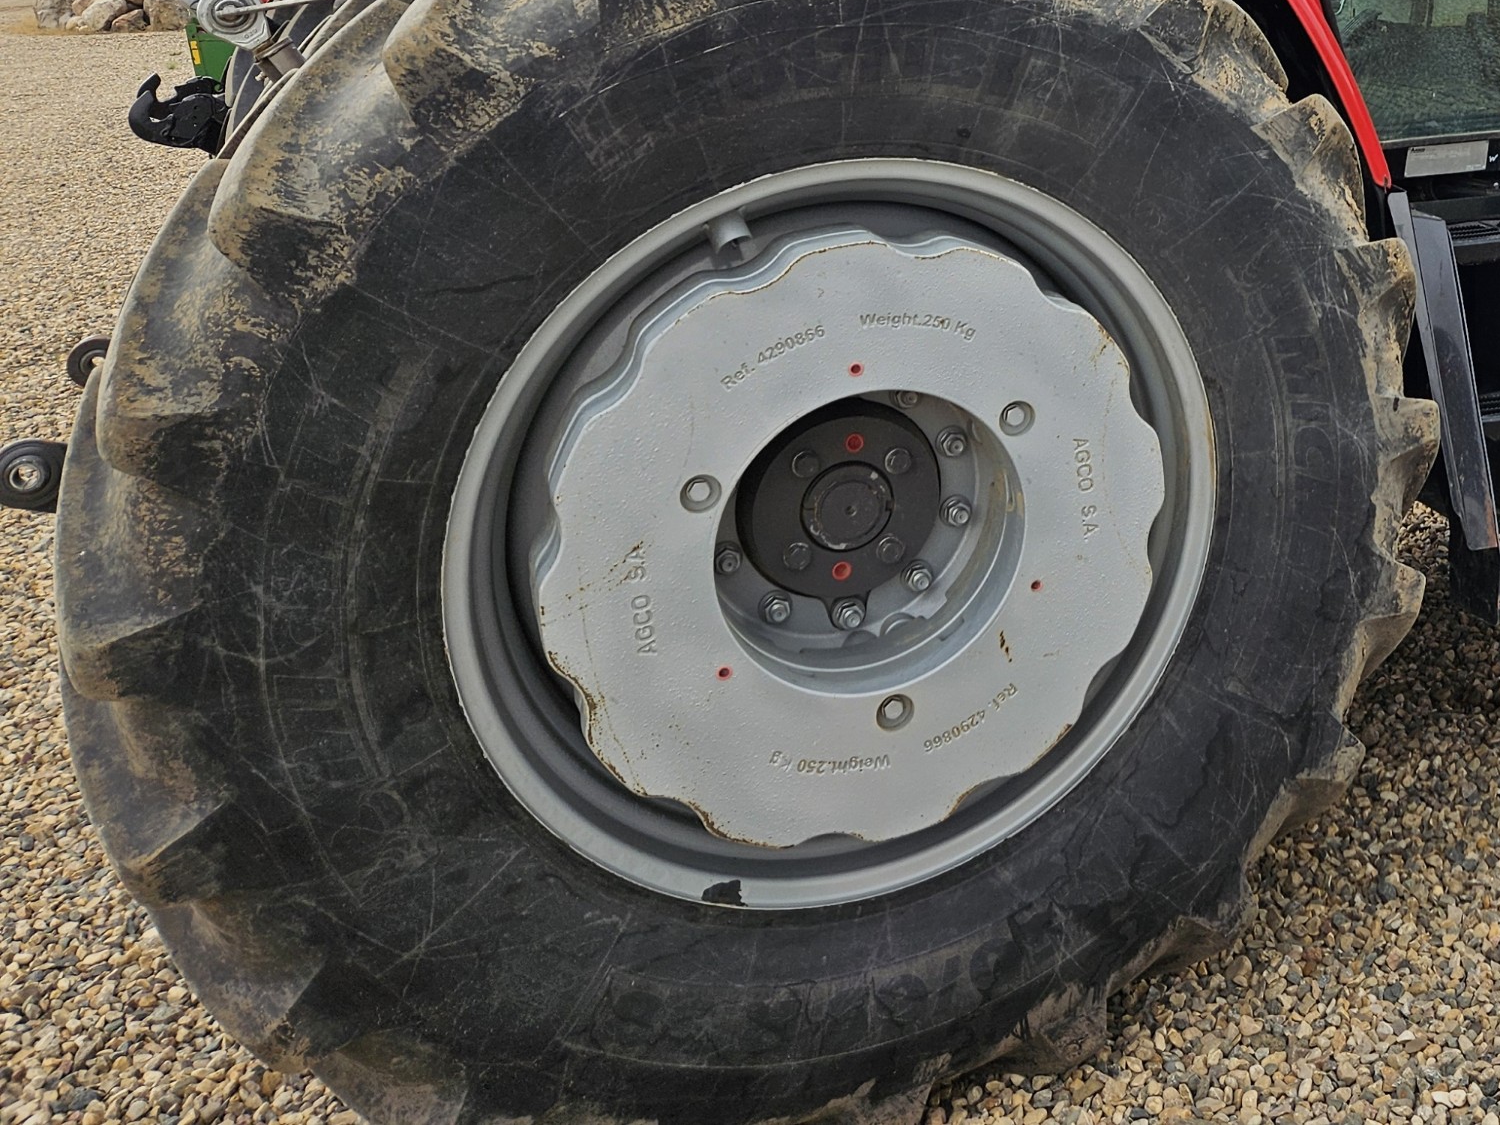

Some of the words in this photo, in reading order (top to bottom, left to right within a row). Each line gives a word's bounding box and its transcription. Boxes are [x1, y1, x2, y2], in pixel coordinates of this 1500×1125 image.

[720, 361, 756, 391] Ref.
[756, 324, 826, 365] 4290866
[955, 321, 977, 341] Kg
[1072, 438, 1094, 492] AGCO
[630, 594, 658, 654] AGCO
[923, 709, 986, 753] 4290866
